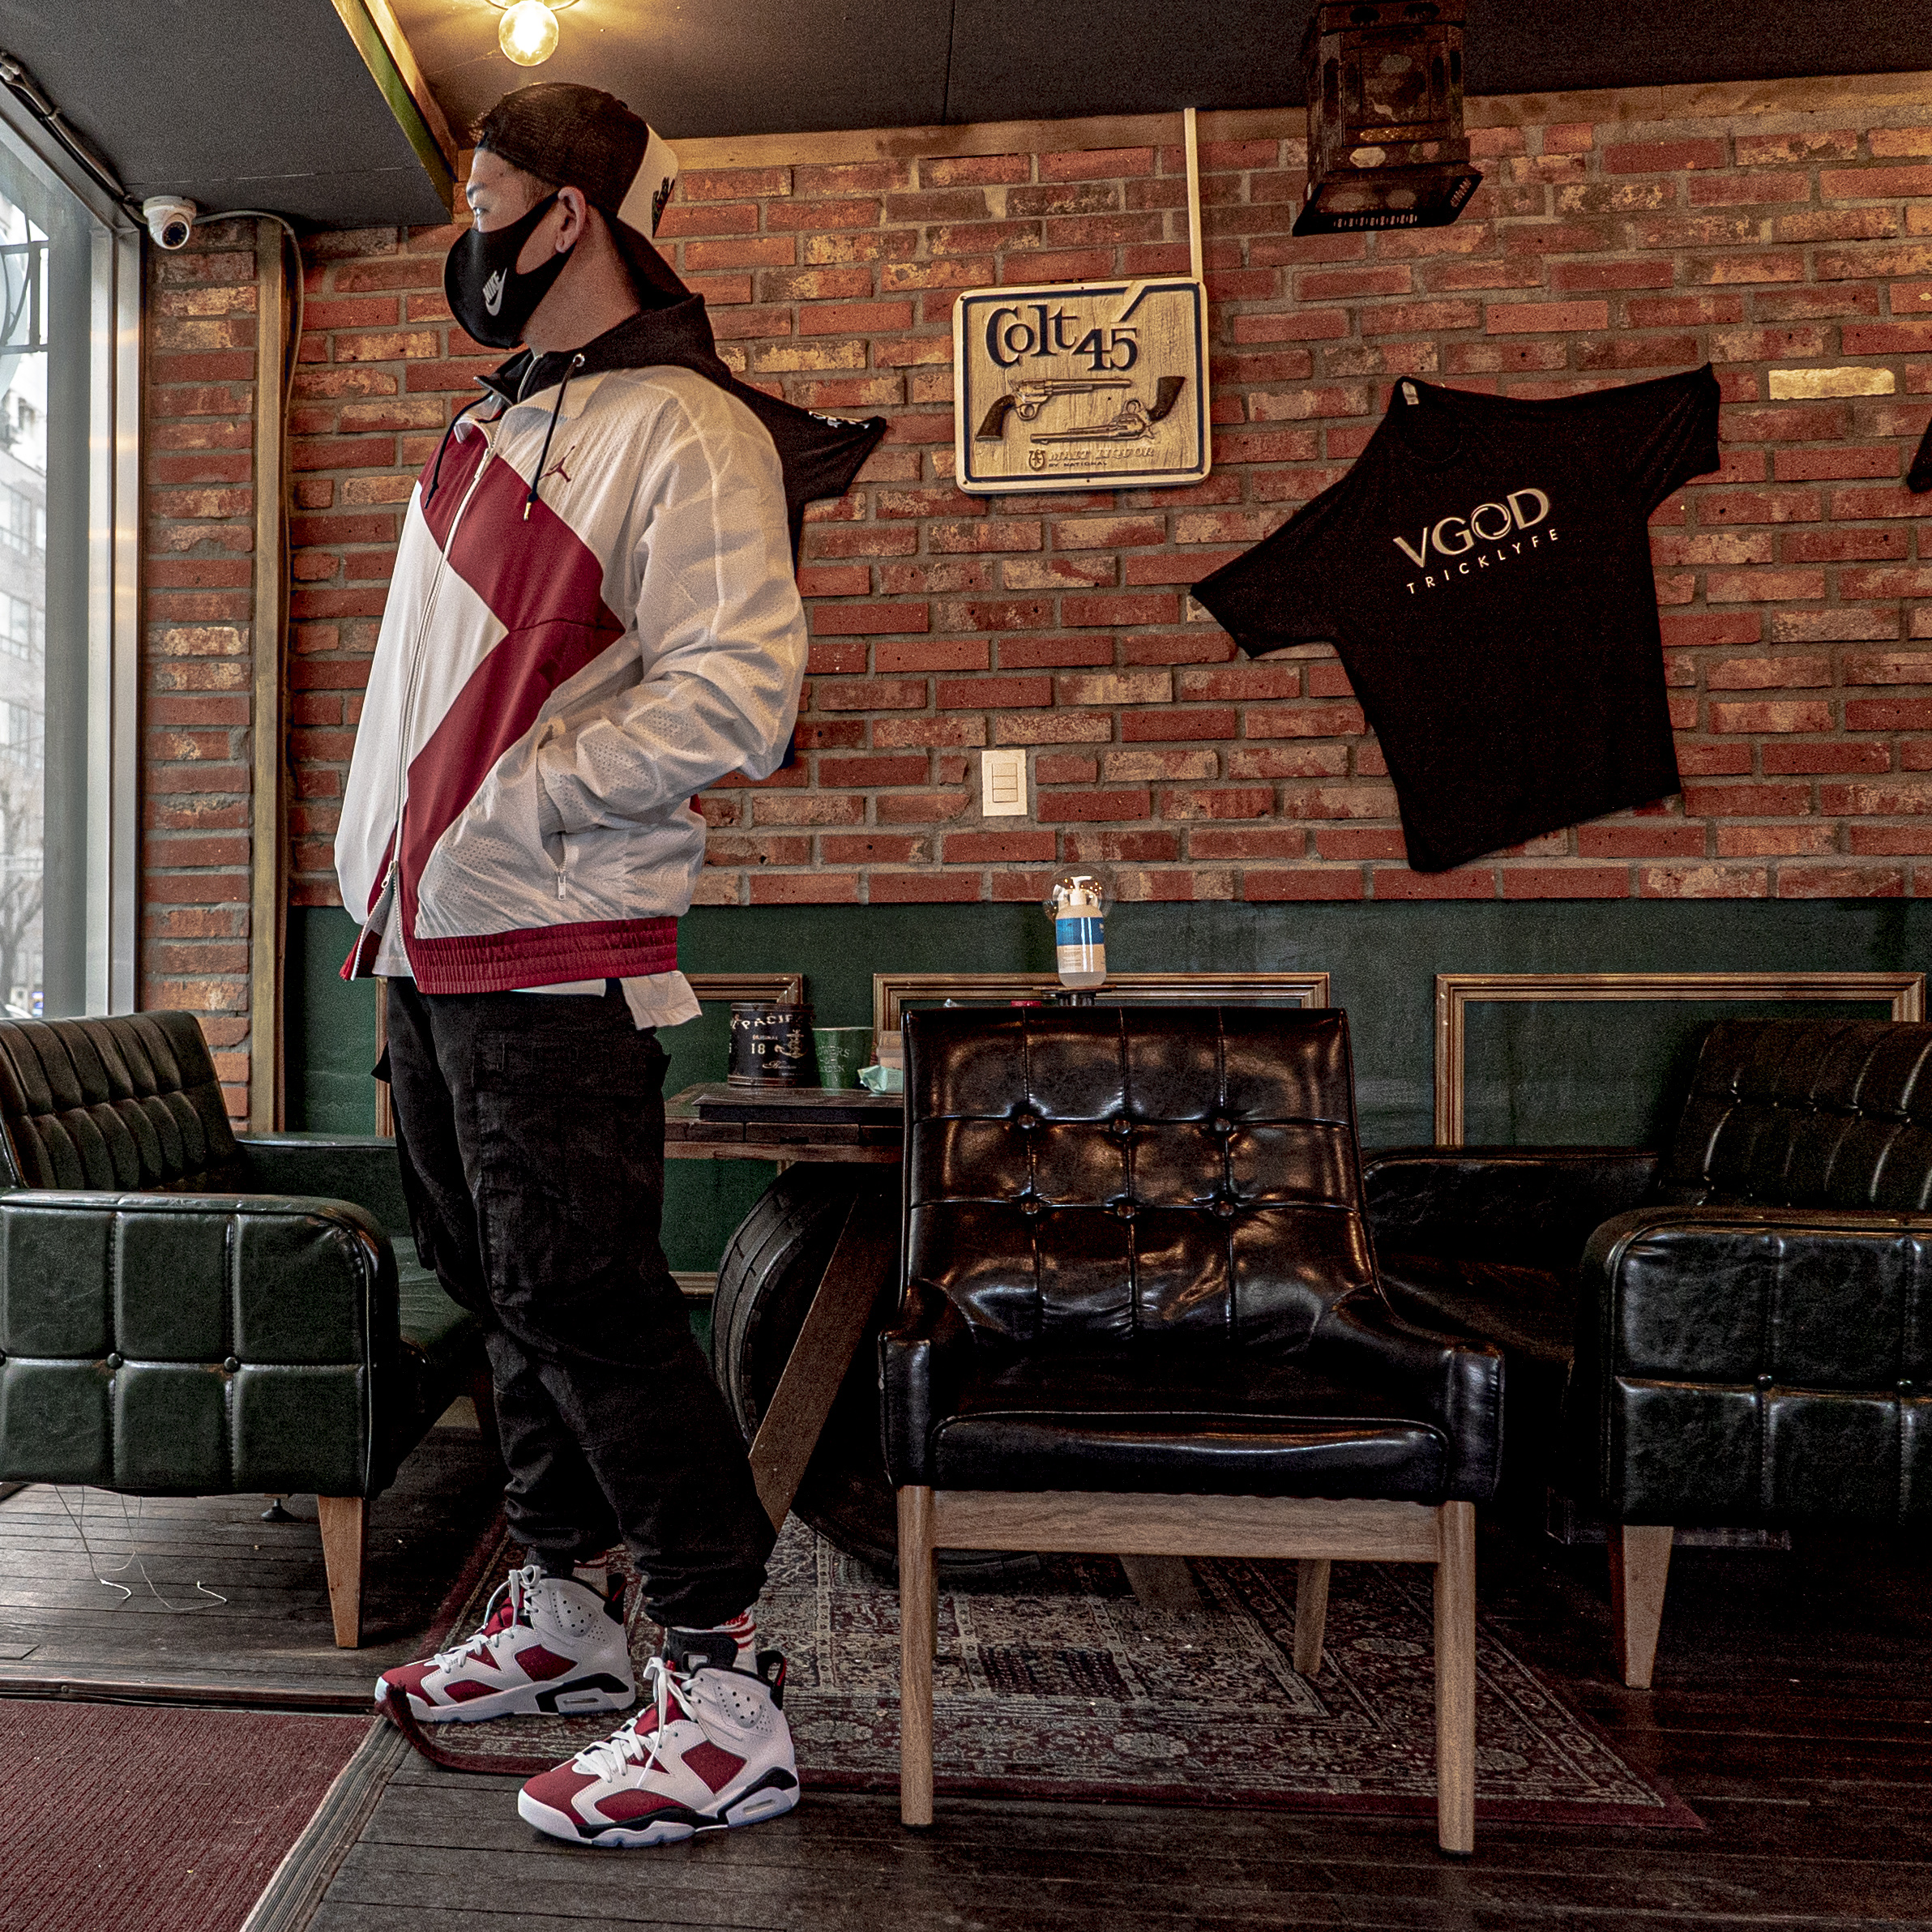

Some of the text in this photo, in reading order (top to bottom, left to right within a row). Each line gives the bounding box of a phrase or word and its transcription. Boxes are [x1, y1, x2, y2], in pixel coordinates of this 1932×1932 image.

[985, 304, 1139, 371] Colt 45
[1392, 488, 1549, 568] VGOD
[1406, 528, 1558, 594] TRICKLYFE
